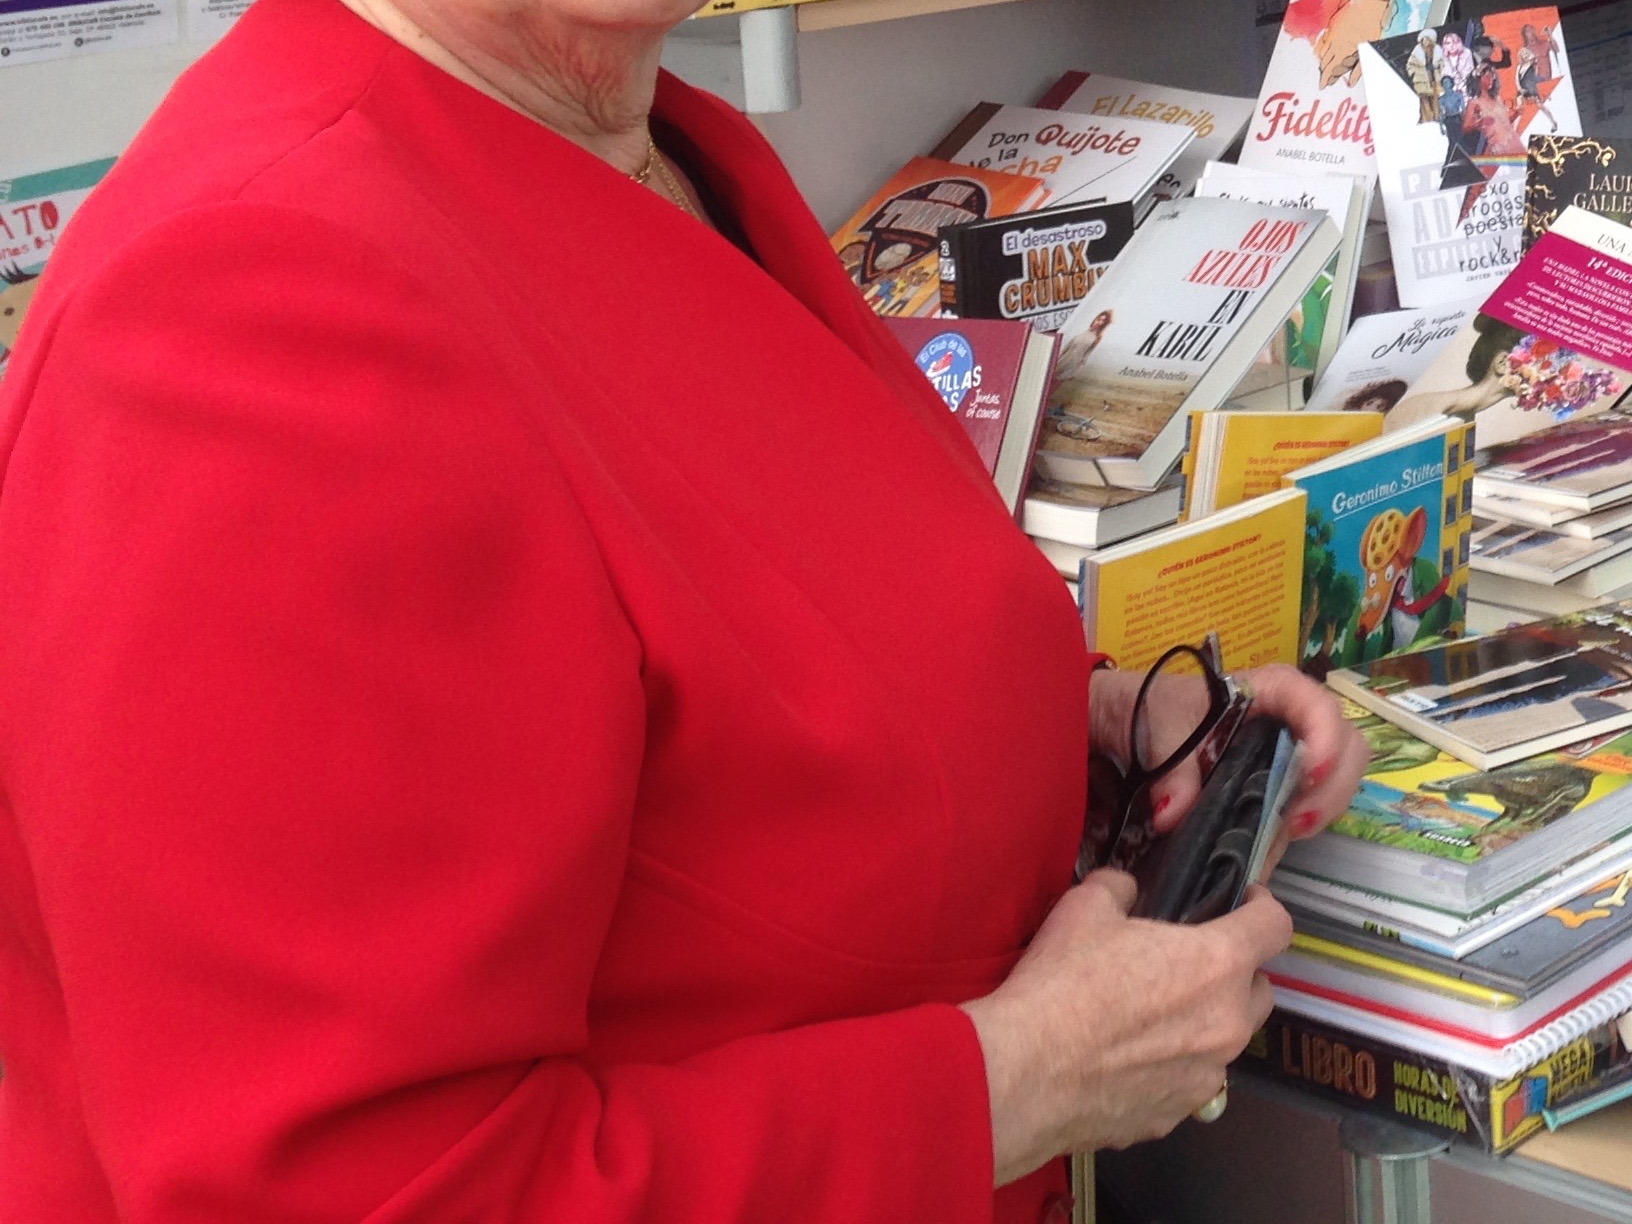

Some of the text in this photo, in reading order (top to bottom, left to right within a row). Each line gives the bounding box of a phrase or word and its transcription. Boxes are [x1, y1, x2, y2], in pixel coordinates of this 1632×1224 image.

[1092, 93, 1216, 139] El Lazarillo
[1256, 90, 1376, 160] Fidelity
[987, 122, 1142, 156] Don Quijote
[998, 145, 1018, 164] la
[1276, 148, 1346, 165] ANABEL BOTELLA
[1004, 221, 1104, 252] El desastroso
[1238, 217, 1309, 254] OJOS
[1597, 233, 1626, 253] UNA
[1026, 239, 1089, 280] MAX
[1183, 249, 1282, 289] AZULES
[1212, 289, 1256, 326] EN
[929, 340, 947, 354] Club
[1136, 321, 1223, 363] KABUL
[1118, 365, 1189, 382] Anabel Botella
[1332, 461, 1444, 515] Geronimo Stilton
[1280, 1026, 1379, 1100] LIBRO
